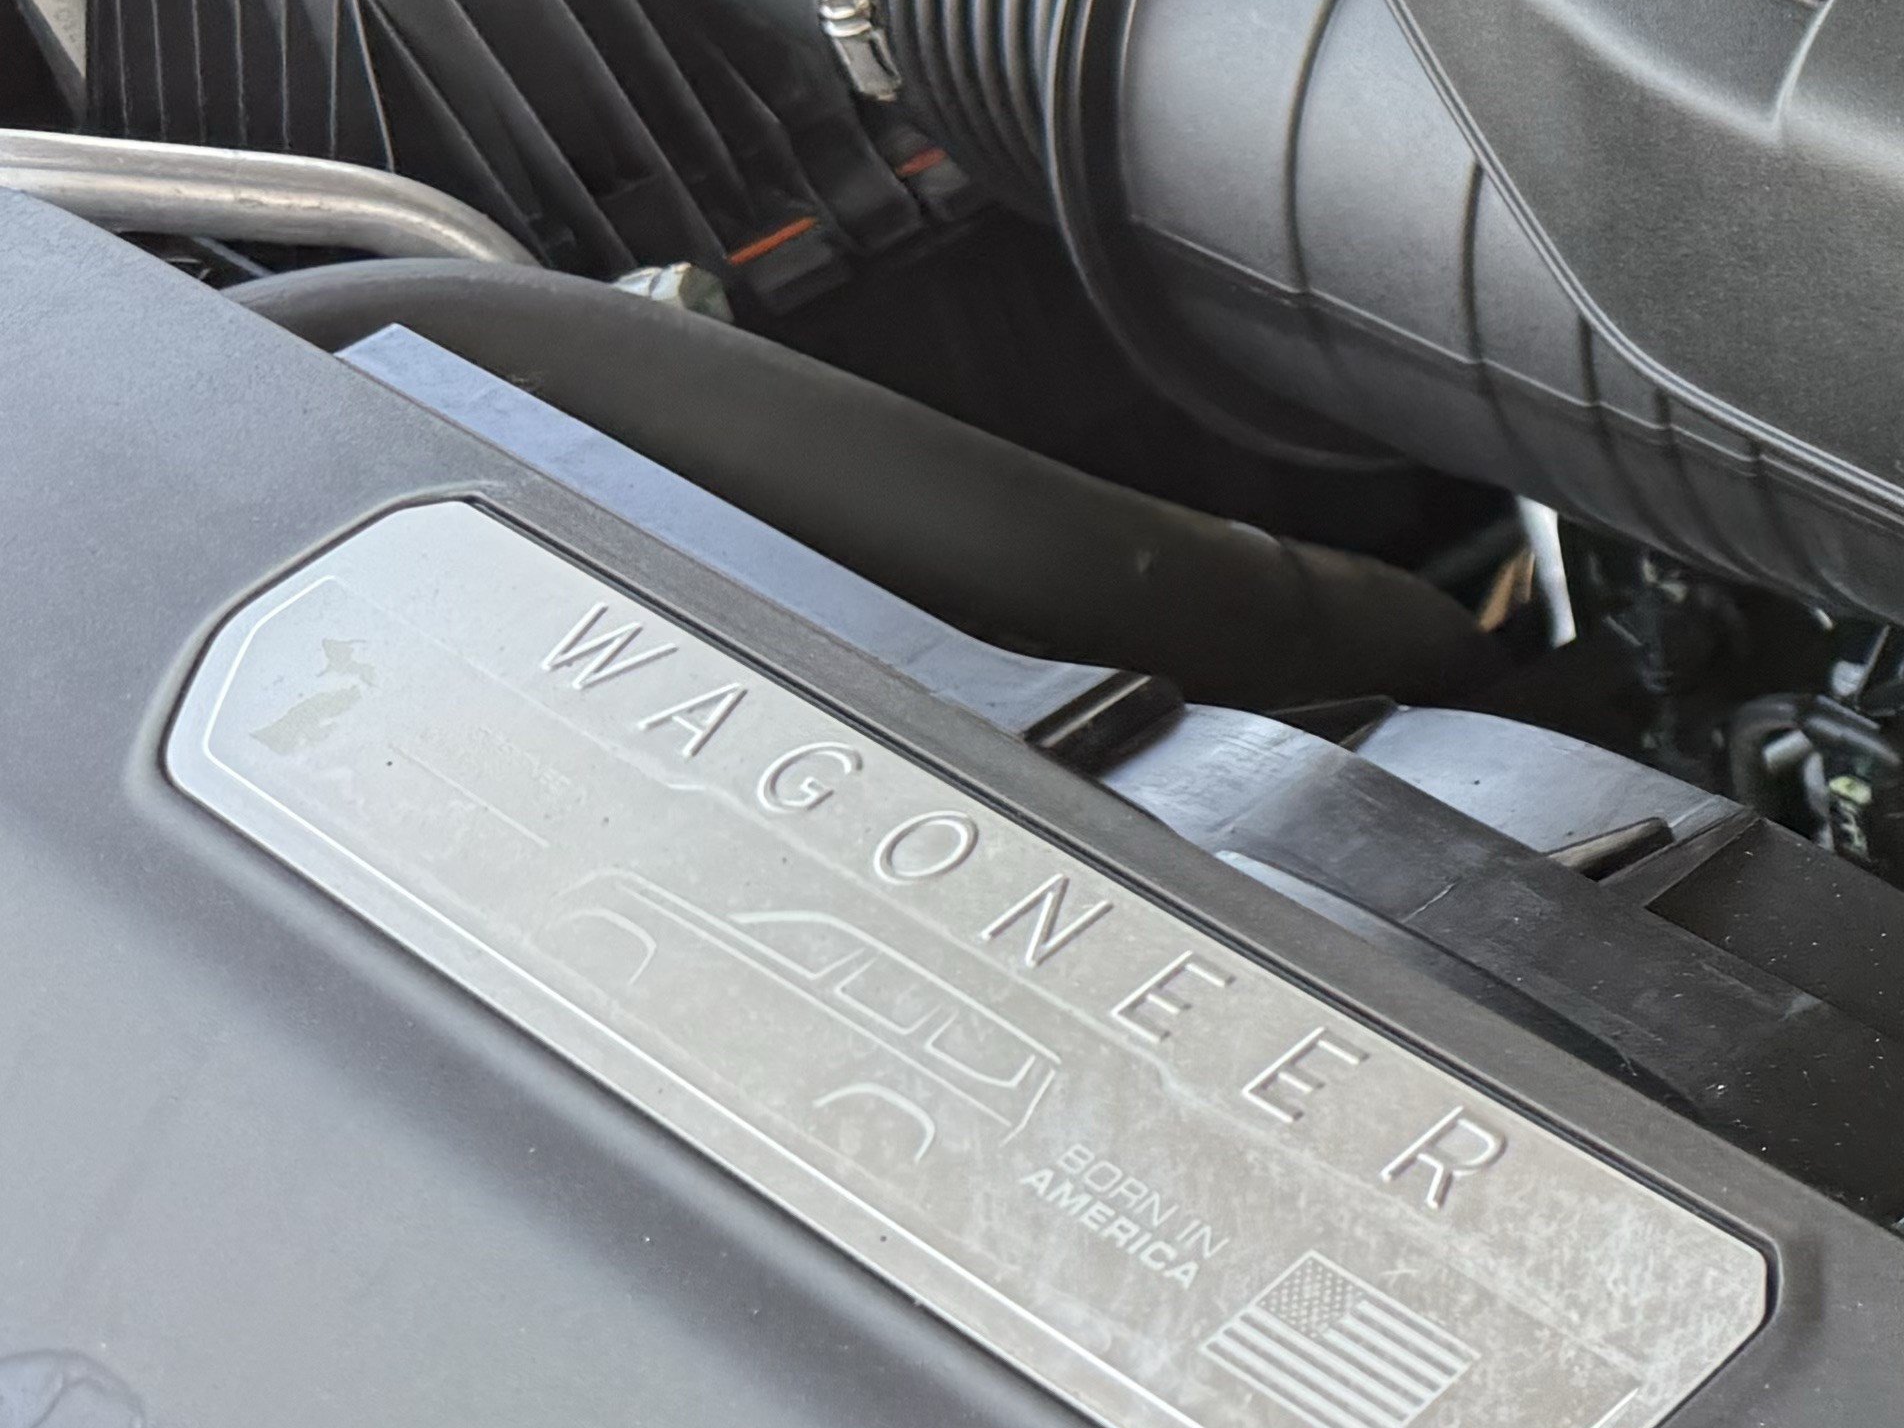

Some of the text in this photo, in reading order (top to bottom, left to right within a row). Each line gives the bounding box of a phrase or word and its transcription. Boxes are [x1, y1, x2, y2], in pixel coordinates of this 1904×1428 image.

[538, 602, 1508, 1212] WAGONEER
[1019, 1168, 1201, 1290] AMERICA
[1056, 1143, 1231, 1260] BORN IN
